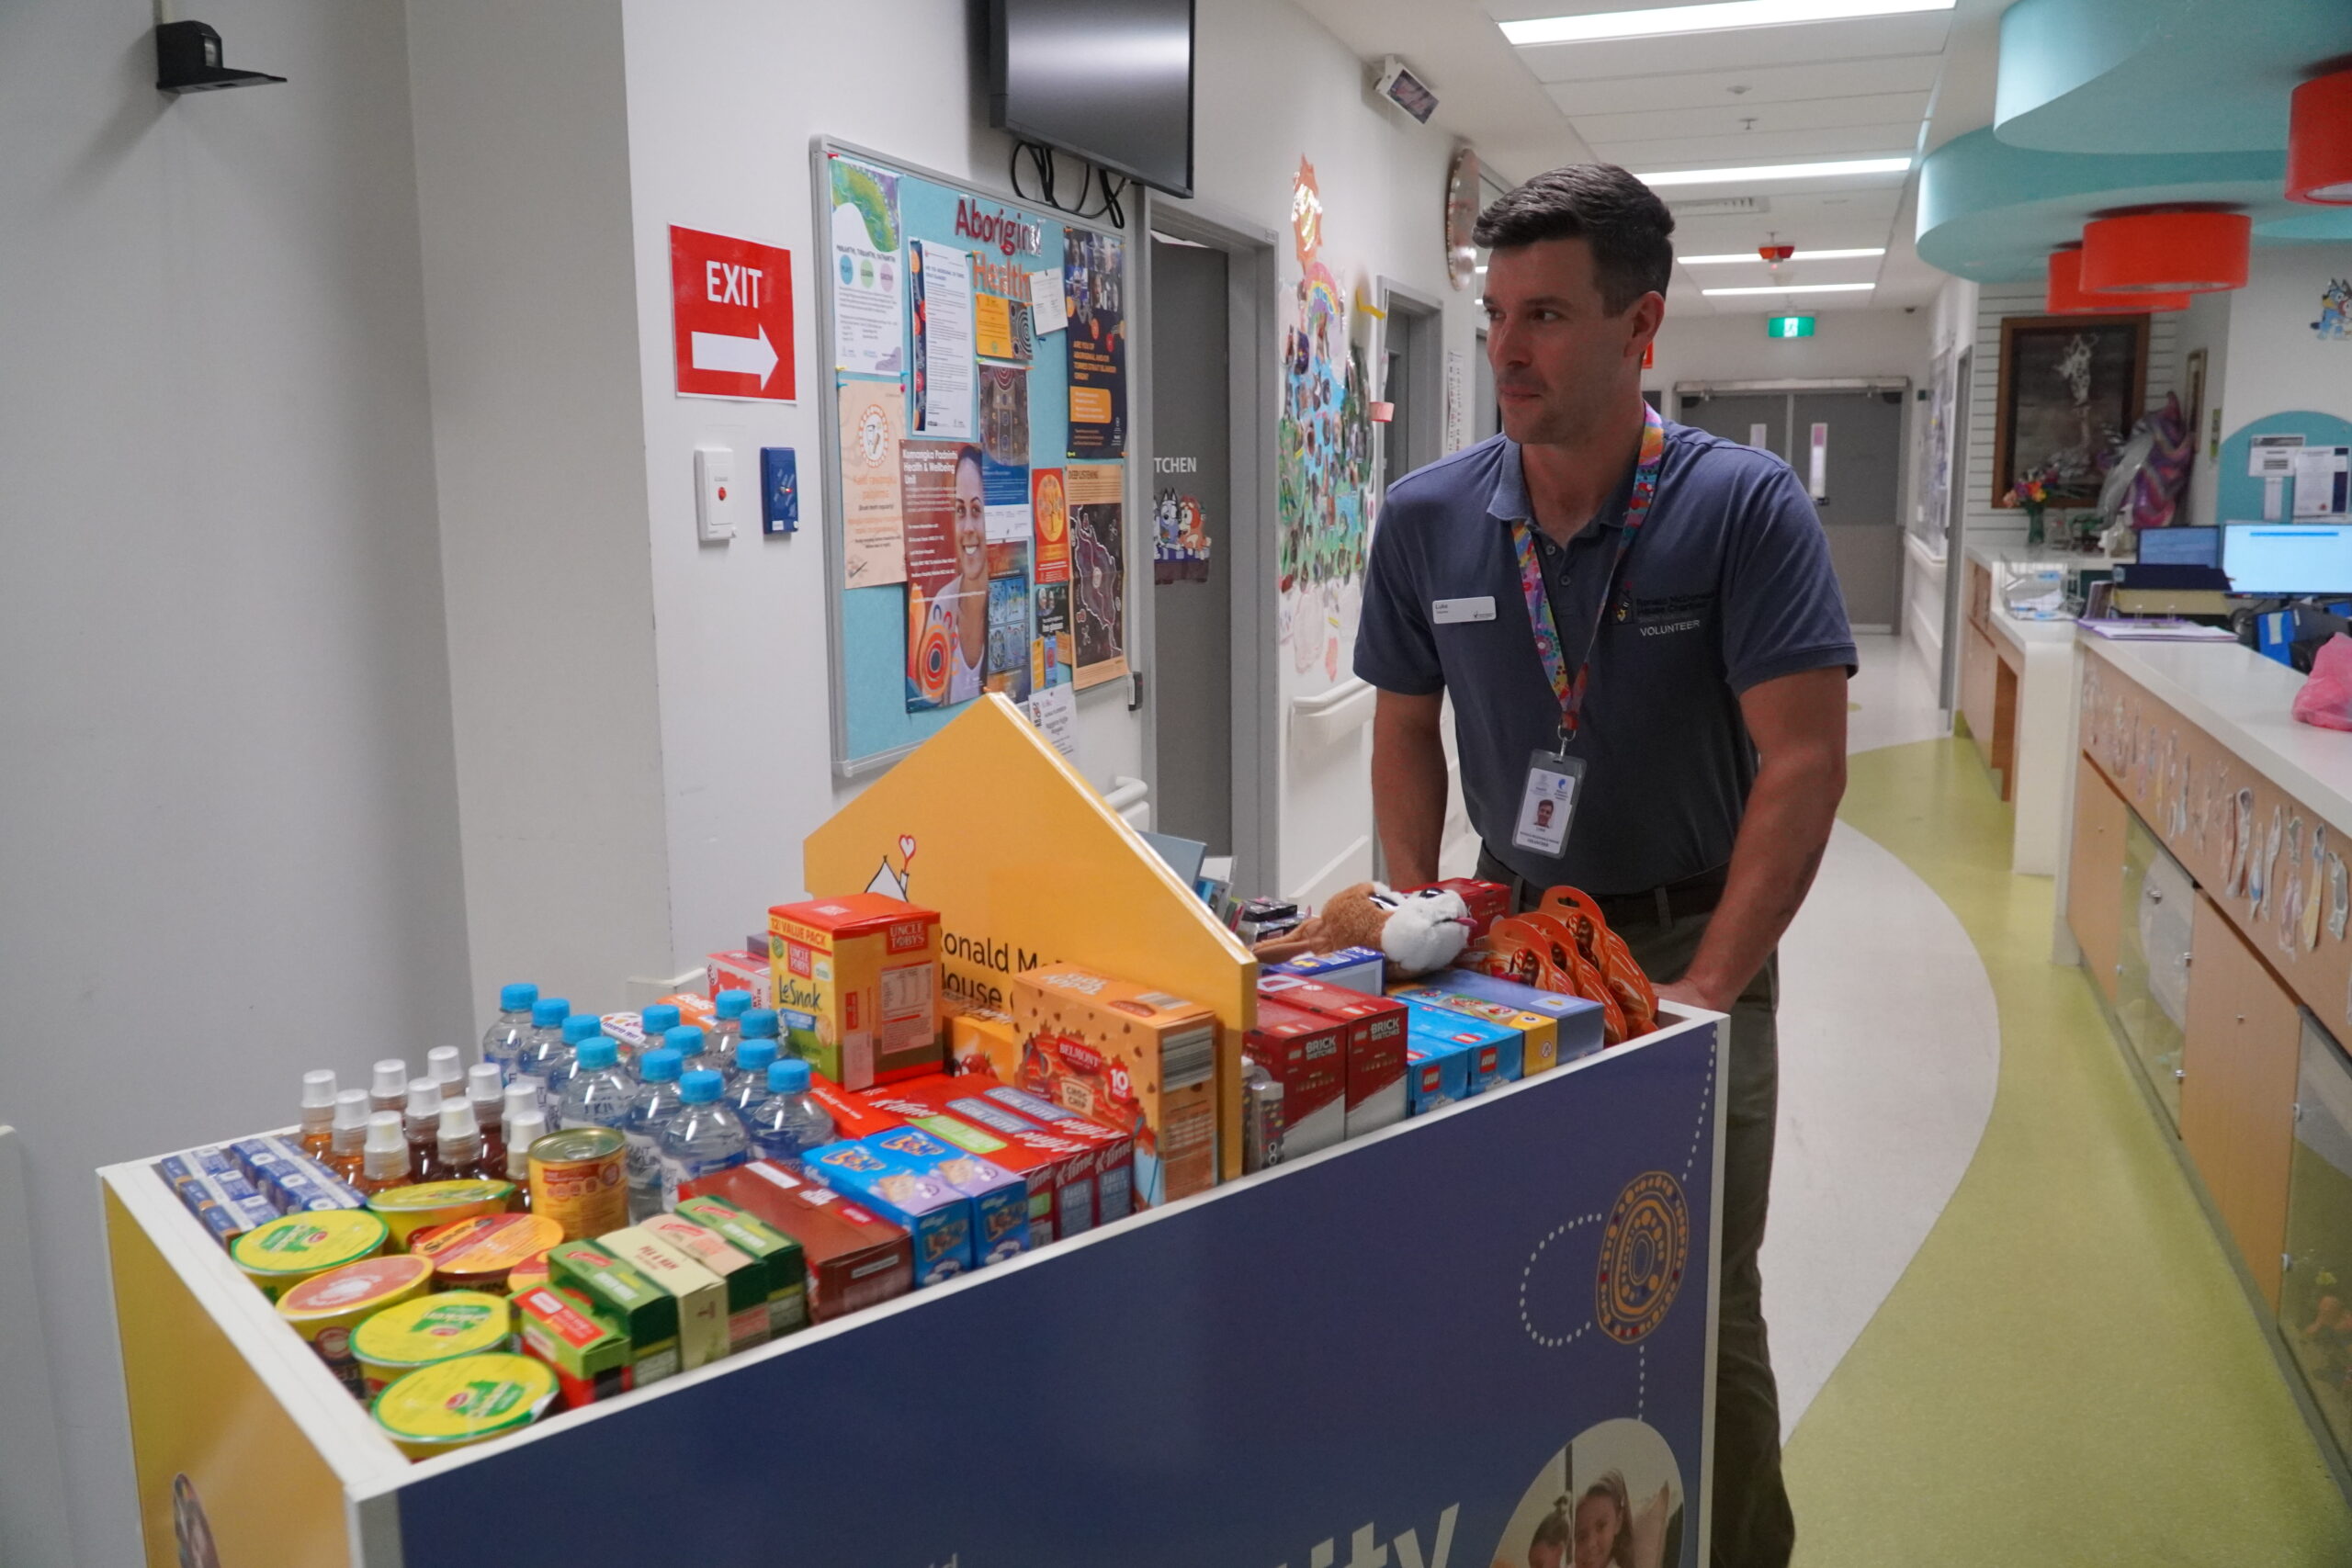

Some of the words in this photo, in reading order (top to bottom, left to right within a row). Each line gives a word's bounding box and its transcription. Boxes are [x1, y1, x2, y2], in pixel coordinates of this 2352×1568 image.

[706, 260, 763, 309] EXIT
[1639, 619, 1701, 637] VOLUNTEER
[780, 919, 805, 938] VALUE
[806, 929, 827, 947] PACK
[889, 921, 924, 938] UNCLE
[891, 933, 925, 950] TOBYS
[941, 927, 1010, 974] onald
[791, 945, 810, 963] UNCLE
[1370, 1018, 1400, 1035] BRICK
[1058, 1040, 1101, 1068] BELMONT
[1306, 1035, 1337, 1054] BRICK
[1110, 1068, 1129, 1089] 10
[1066, 1085, 1088, 1100] CHOC
[1067, 1095, 1087, 1110] CHIP
[1094, 1140, 1133, 1175] K-Time
[1056, 1152, 1095, 1189] K-Time
